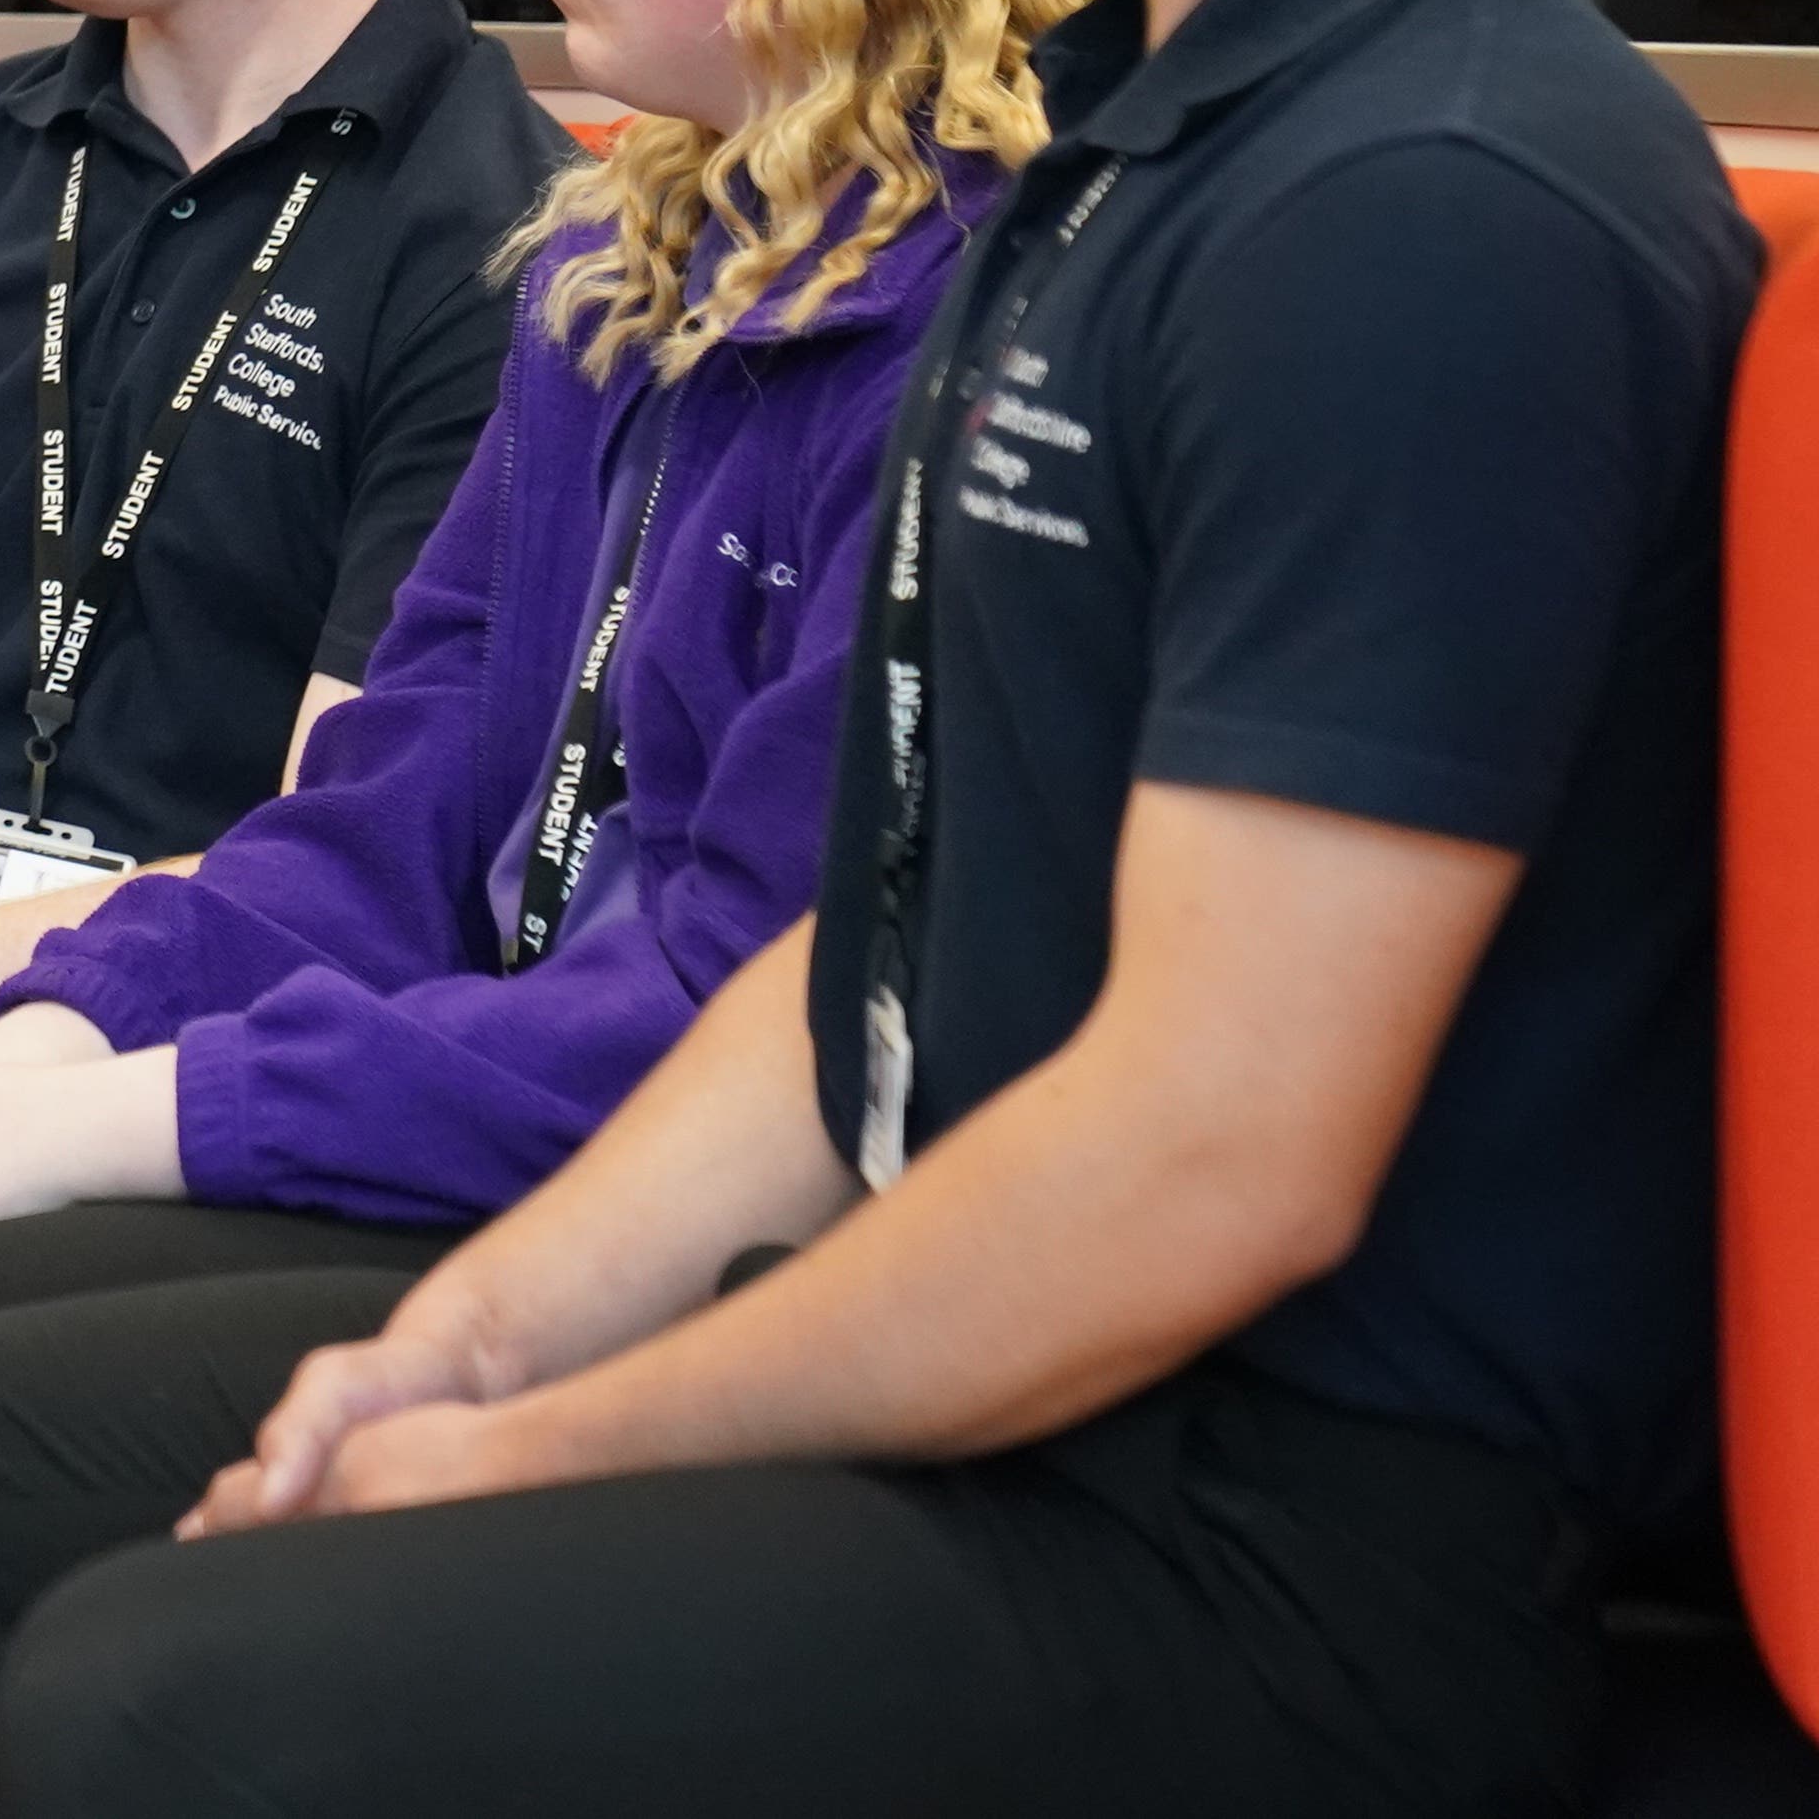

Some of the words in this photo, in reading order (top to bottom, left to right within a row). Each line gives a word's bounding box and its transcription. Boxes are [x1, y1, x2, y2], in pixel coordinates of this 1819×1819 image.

[57, 146, 87, 242] STUDENT
[253, 172, 319, 273] STUDENT
[41, 282, 67, 385] STUDENT
[171, 310, 238, 412] STUDENT
[264, 293, 318, 329] South
[214, 385, 259, 419] Public
[227, 352, 296, 398] College
[41, 428, 65, 536] STUDENT
[101, 450, 165, 560] STUDENT
[44, 599, 98, 695] TUDENT
[579, 585, 632, 693] STUDENT
[537, 742, 588, 867] STUDENT
